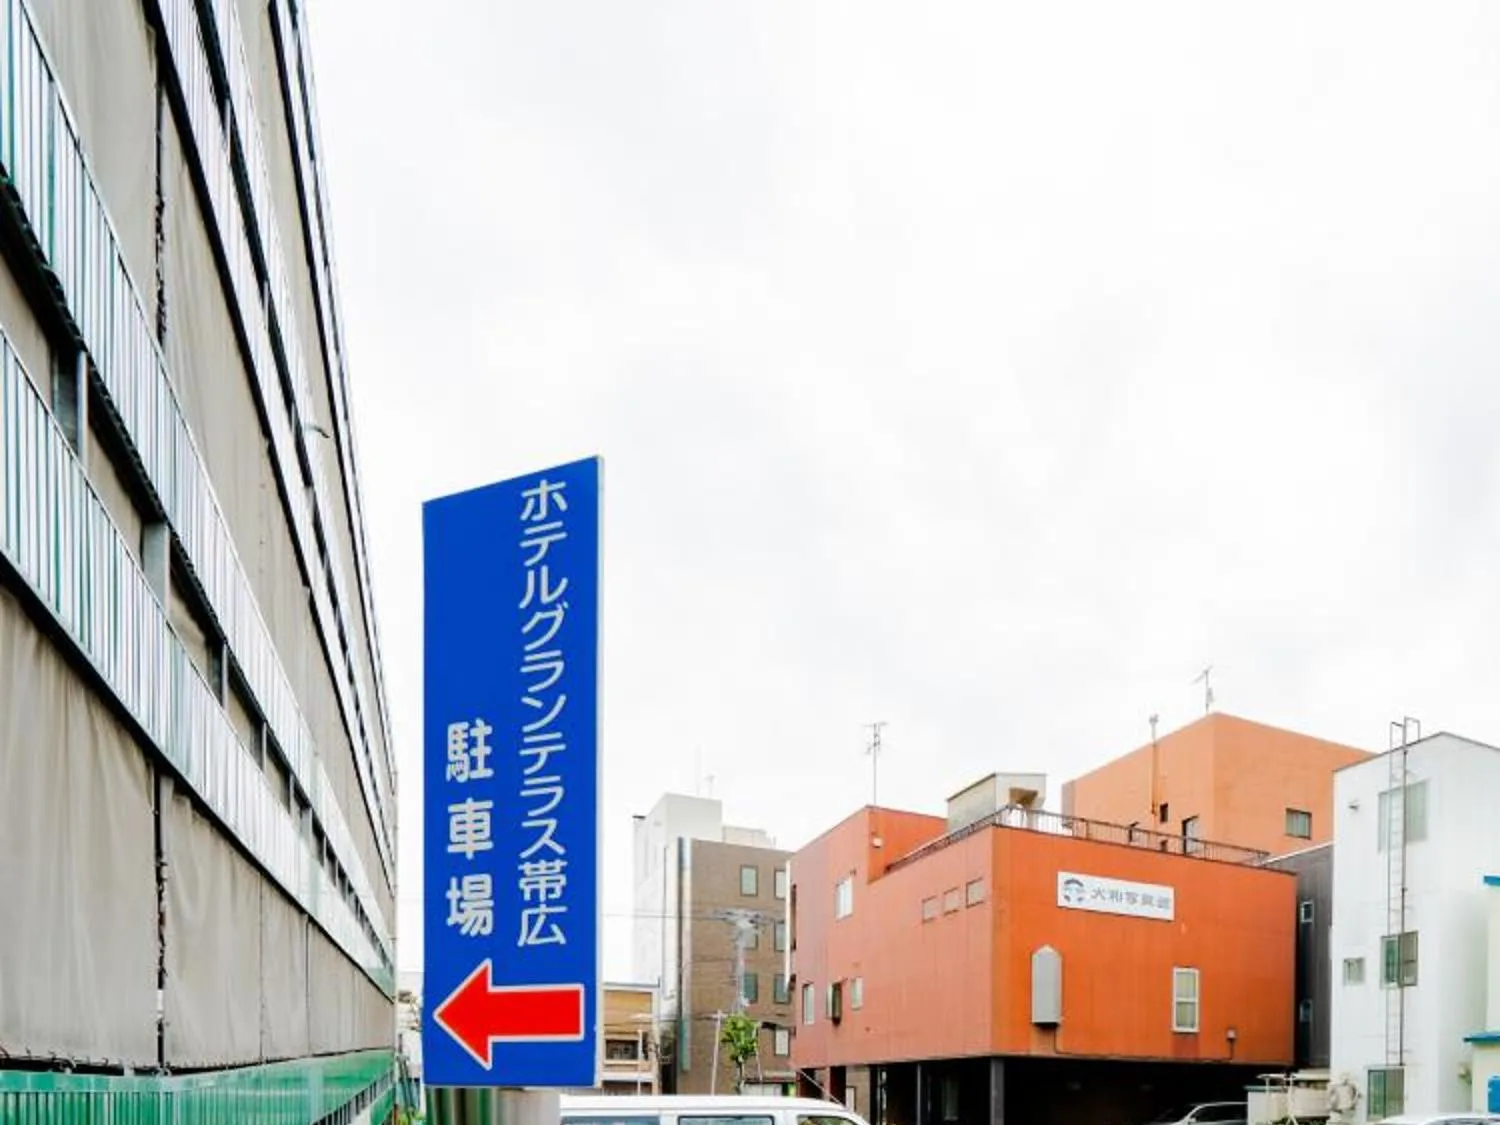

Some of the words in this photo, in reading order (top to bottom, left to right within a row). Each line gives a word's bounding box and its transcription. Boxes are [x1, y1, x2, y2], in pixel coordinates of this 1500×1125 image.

[446, 717, 495, 938] 駐車場
[517, 478, 569, 947] ホテルグランテラス帯広
